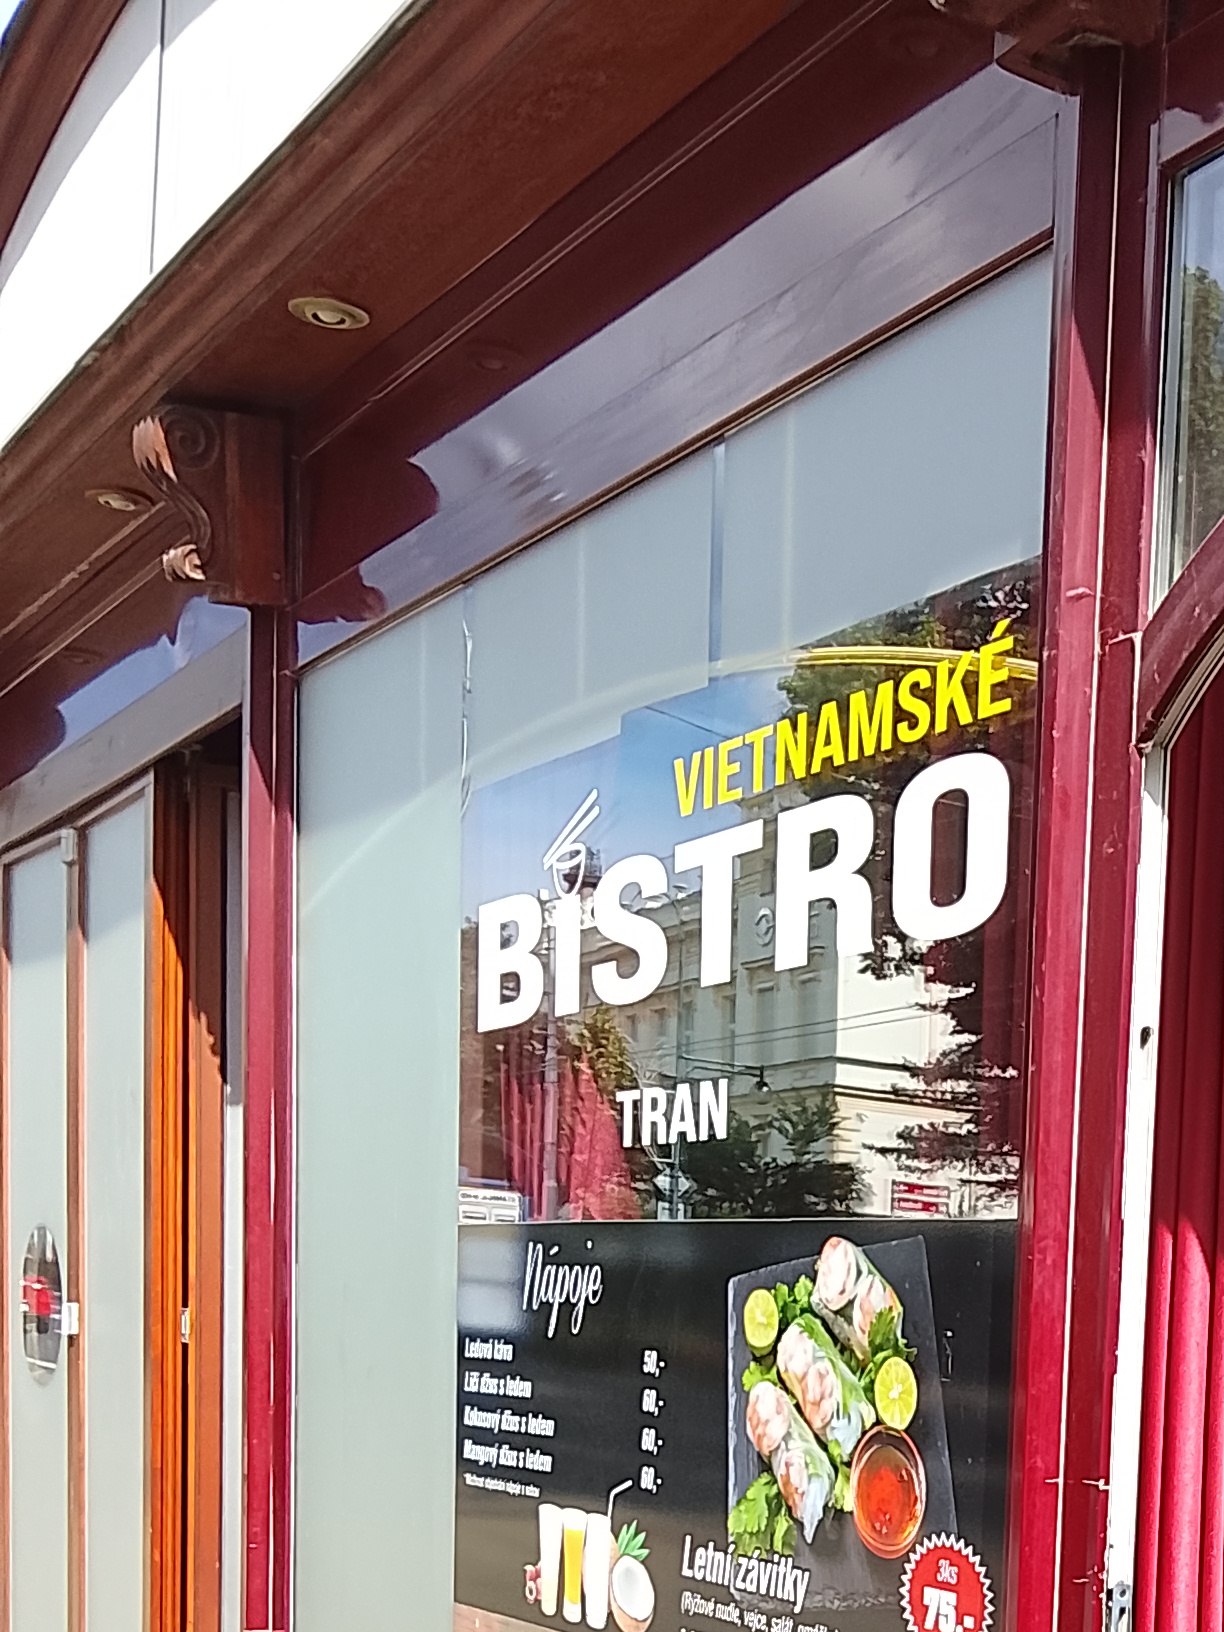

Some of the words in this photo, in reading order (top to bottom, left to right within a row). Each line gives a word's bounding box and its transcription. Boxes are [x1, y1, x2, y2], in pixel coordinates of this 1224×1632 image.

[674, 618, 1016, 818] VIETNAMSKÉ
[476, 751, 1010, 1034] BISTRO
[616, 1078, 730, 1149] TRAN
[523, 1241, 603, 1339] Nápoje
[681, 1535, 737, 1587] Letní
[735, 1547, 811, 1615] závitky
